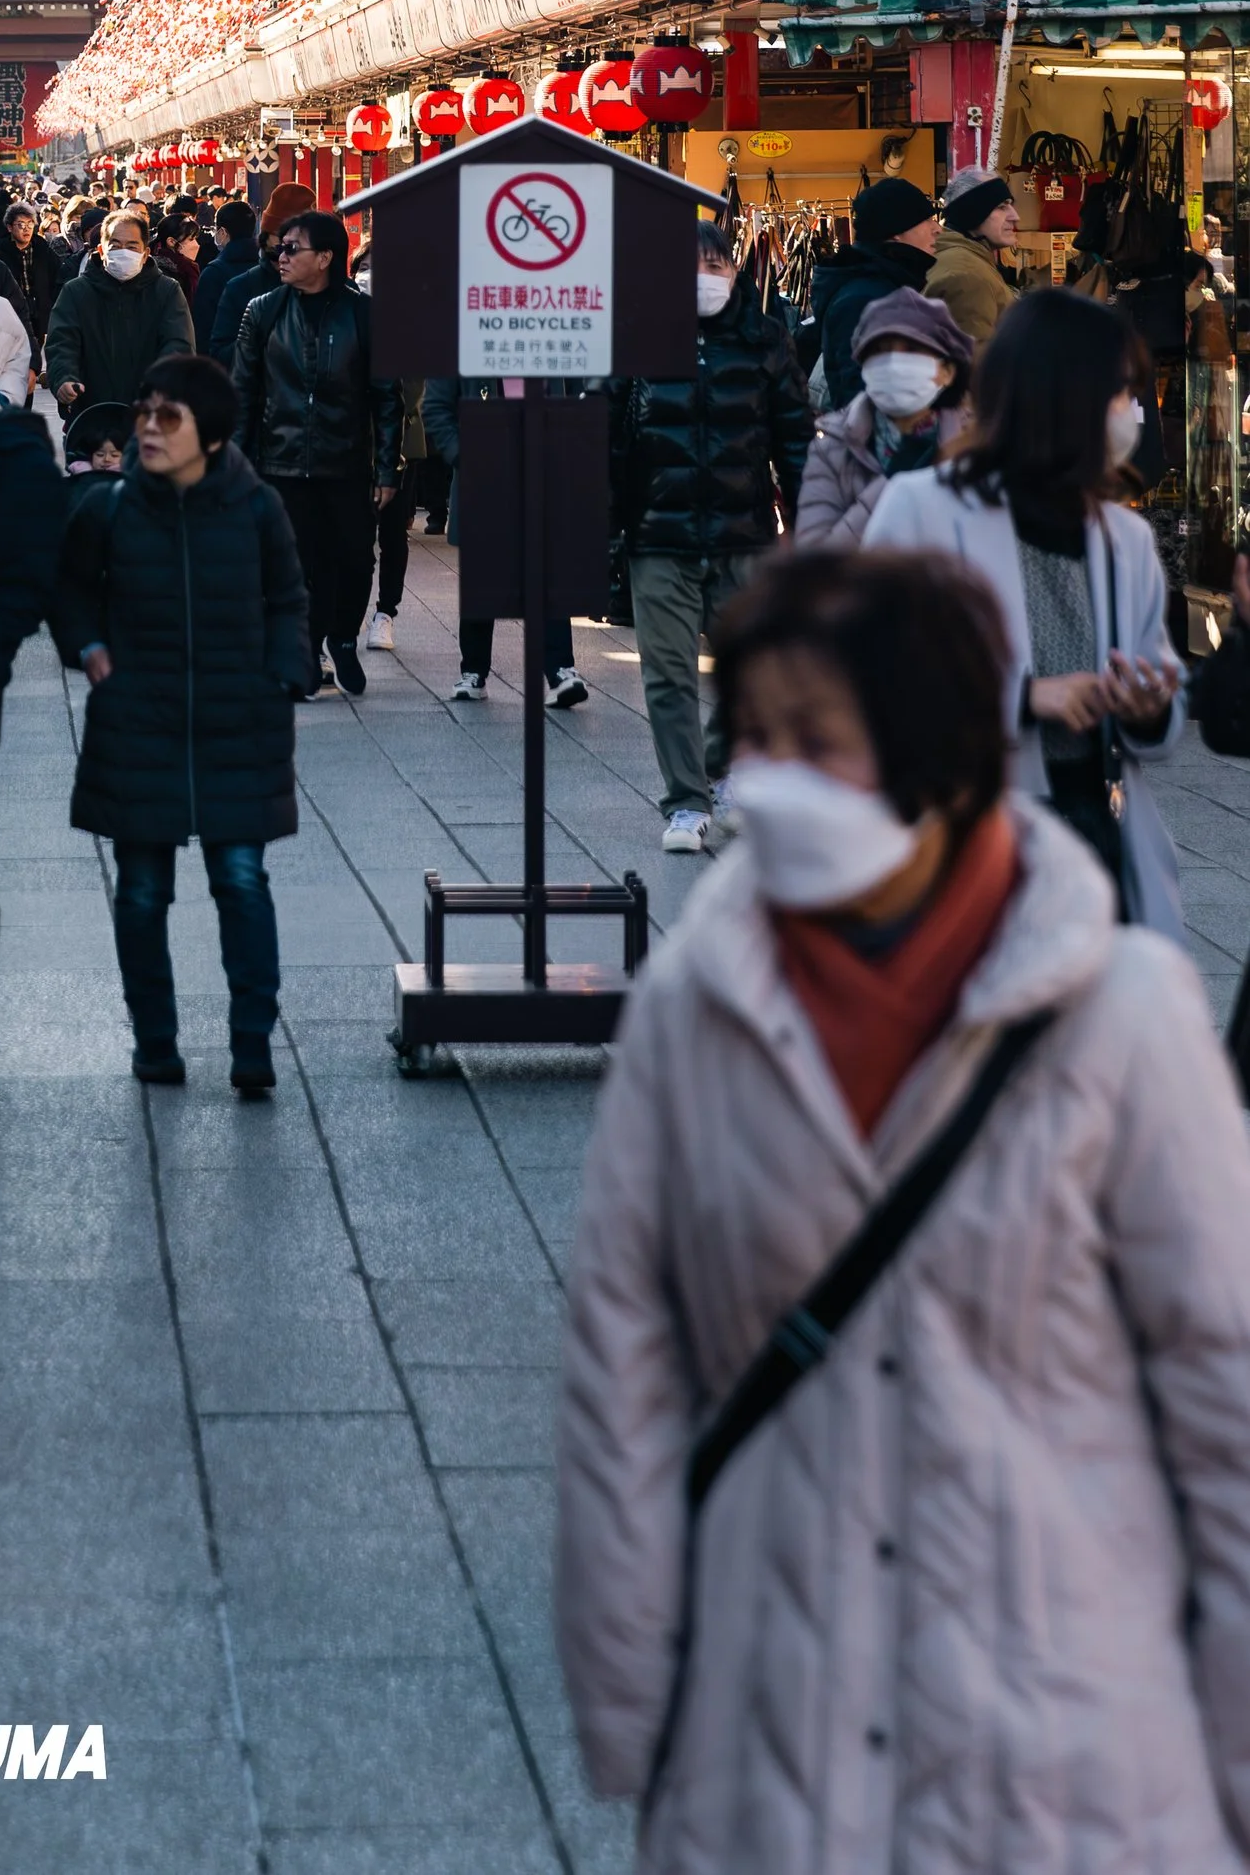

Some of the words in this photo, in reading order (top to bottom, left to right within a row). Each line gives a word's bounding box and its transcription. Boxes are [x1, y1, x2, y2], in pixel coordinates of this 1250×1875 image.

[467, 285, 604, 311] 自転車乗り入れ禁止
[479, 317, 503, 330] NO
[509, 317, 592, 330] BICYCLES
[484, 356, 524, 370] 자전거
